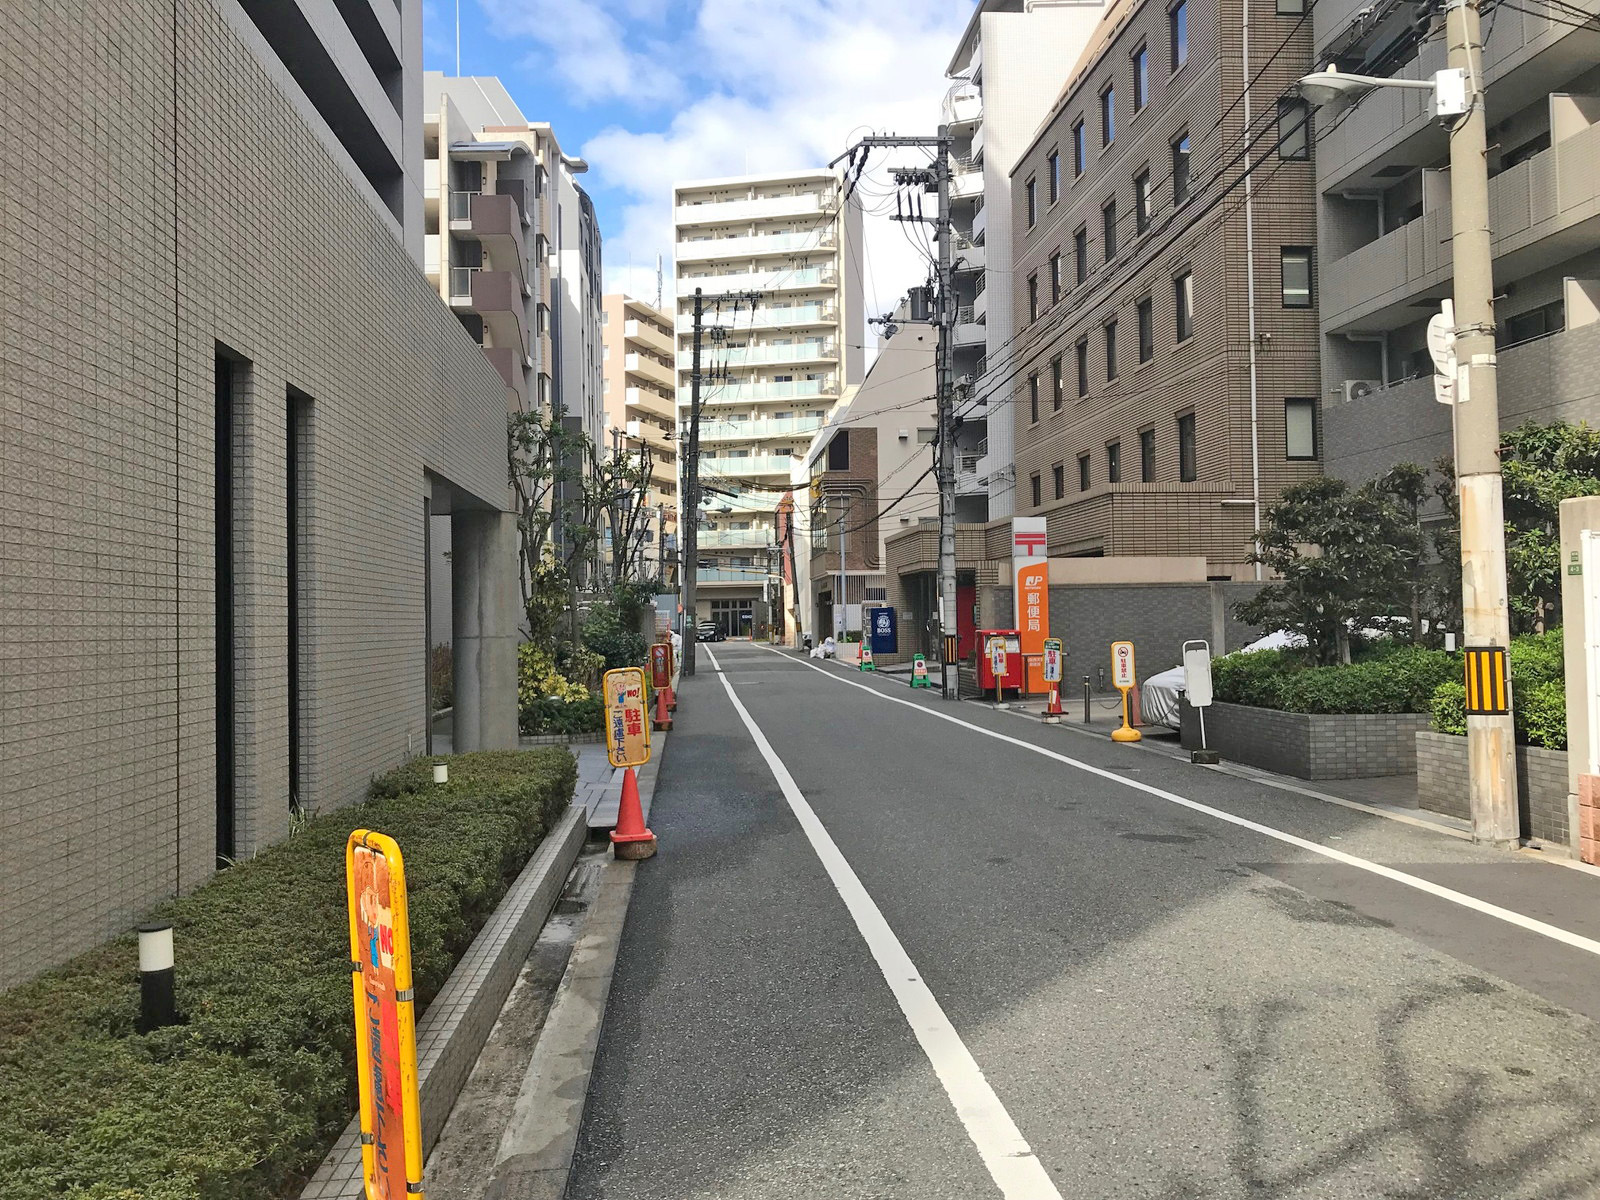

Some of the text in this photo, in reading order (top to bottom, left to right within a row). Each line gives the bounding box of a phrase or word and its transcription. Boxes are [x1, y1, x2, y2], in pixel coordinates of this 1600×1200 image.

[1027, 592, 1040, 632] 郵便局
[626, 687, 640, 698] NO!
[624, 708, 642, 737] 駐車
